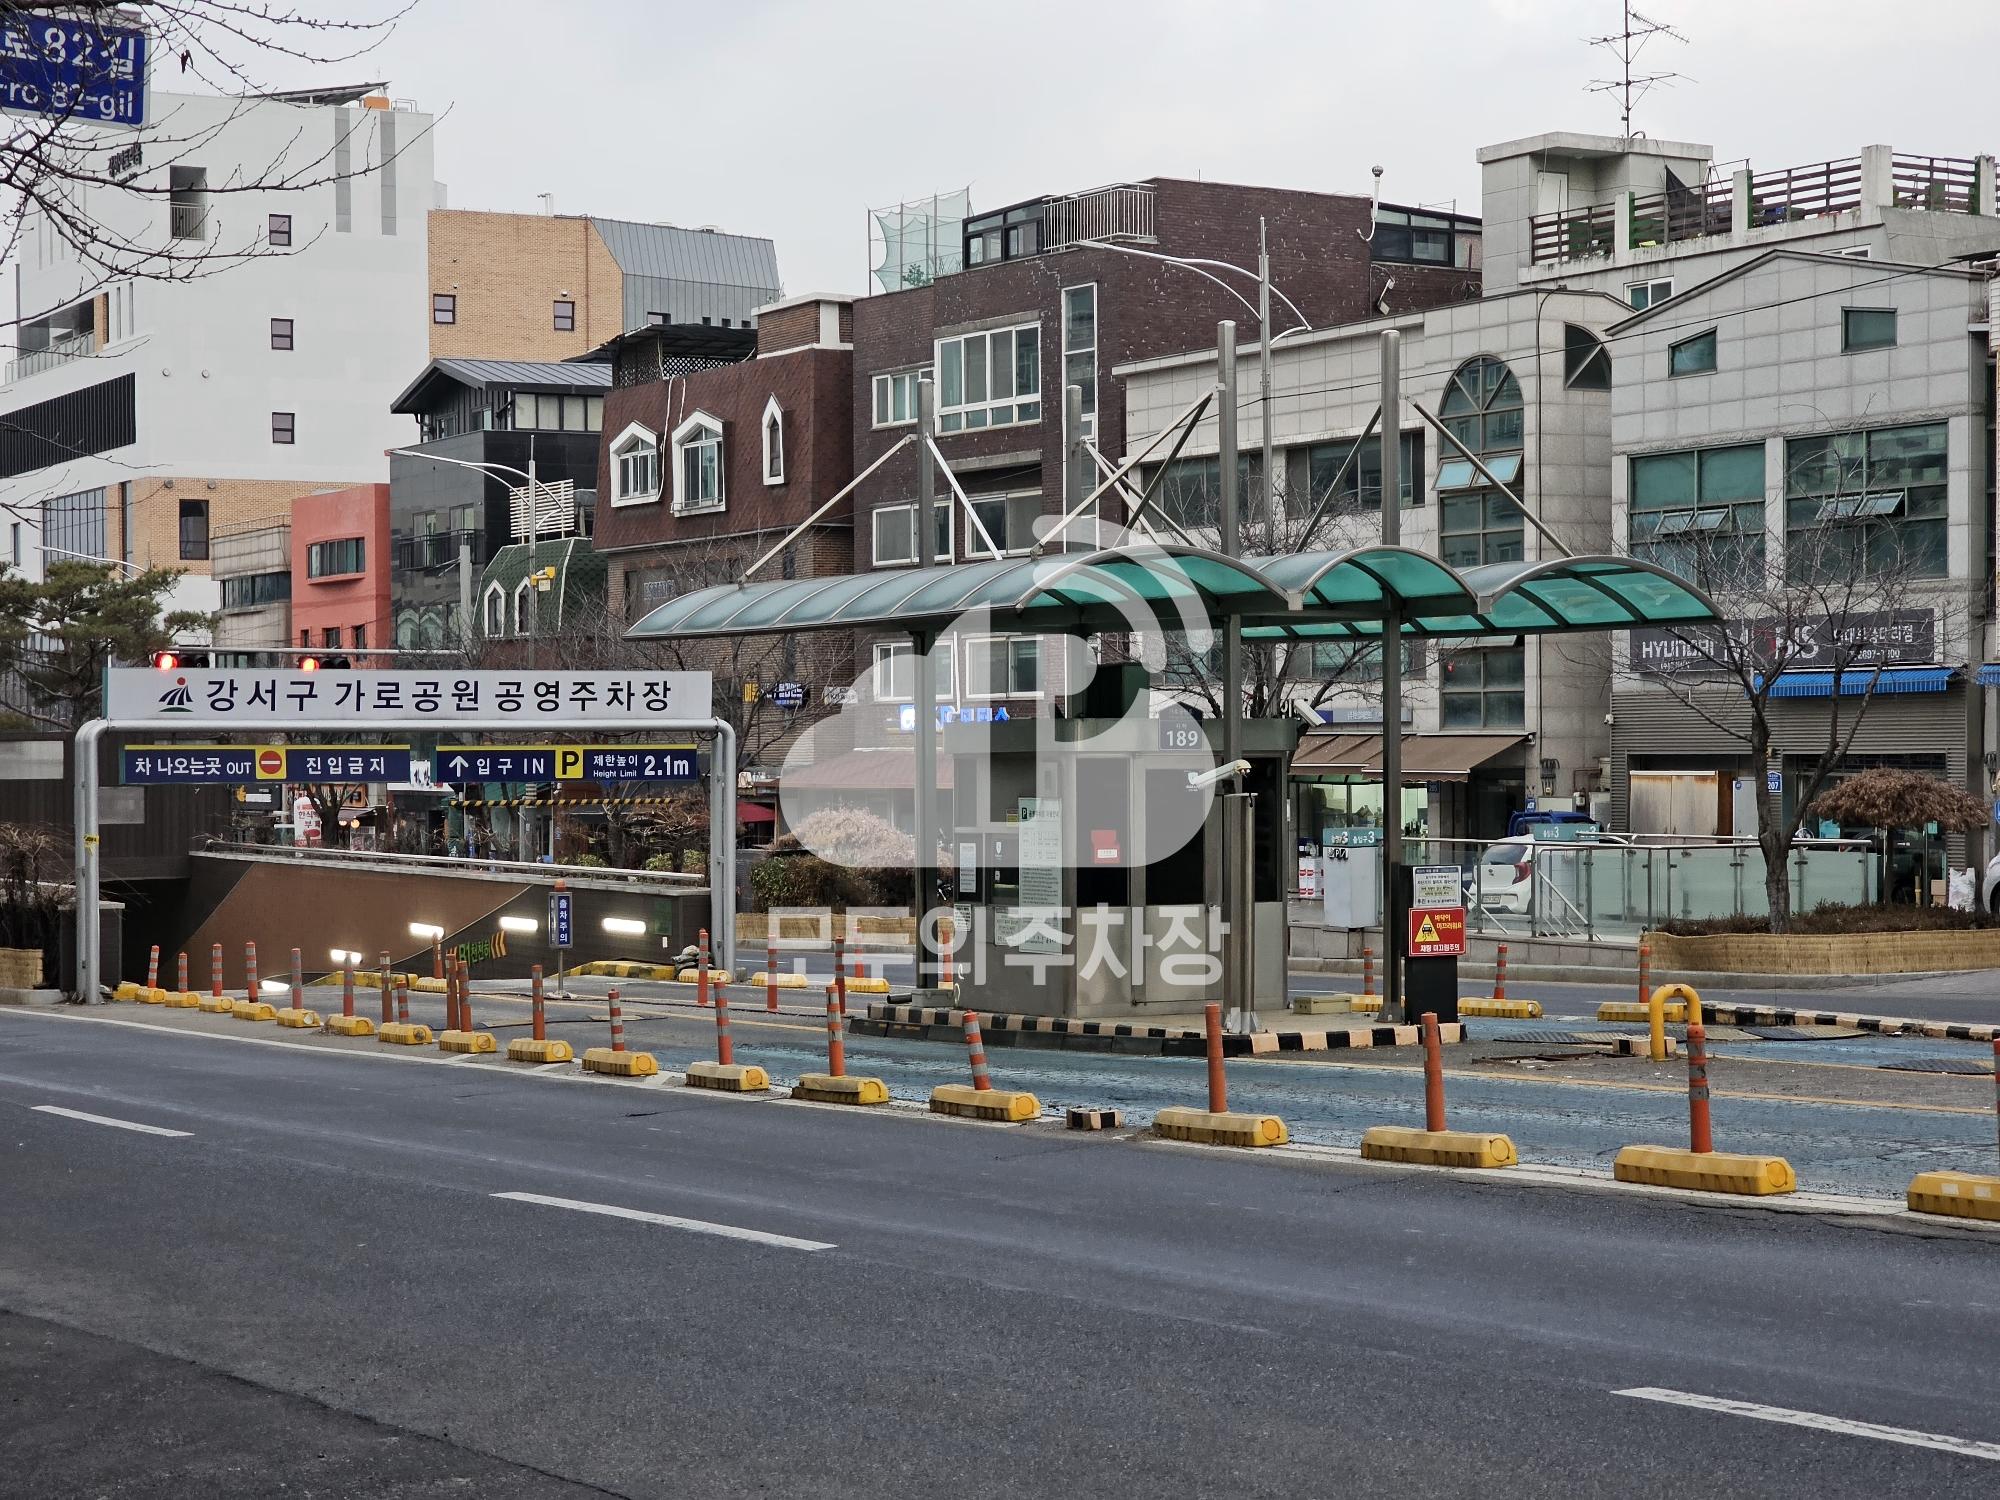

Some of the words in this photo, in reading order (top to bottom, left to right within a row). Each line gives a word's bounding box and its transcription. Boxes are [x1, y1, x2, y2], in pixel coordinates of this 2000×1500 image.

[207, 679, 318, 712] 강서구
[335, 680, 479, 712] 가로공원
[495, 681, 672, 712] 공영주차장
[1166, 730, 1199, 747] 189
[135, 757, 151, 775] 차
[157, 757, 222, 775] 나오는곳
[226, 761, 252, 775] OUT
[523, 758, 545, 773] IN
[562, 751, 580, 775] P
[593, 754, 638, 767] 제한높이
[644, 755, 690, 776] 2.1m
[593, 769, 617, 778] Height
[620, 769, 637, 778] Limit
[1768, 782, 1779, 790] 207
[559, 898, 568, 943] 출차주의
[1434, 913, 1451, 921] 바닥이
[1436, 922, 1462, 930] 미끄러워요
[1420, 944, 1431, 952] 차량
